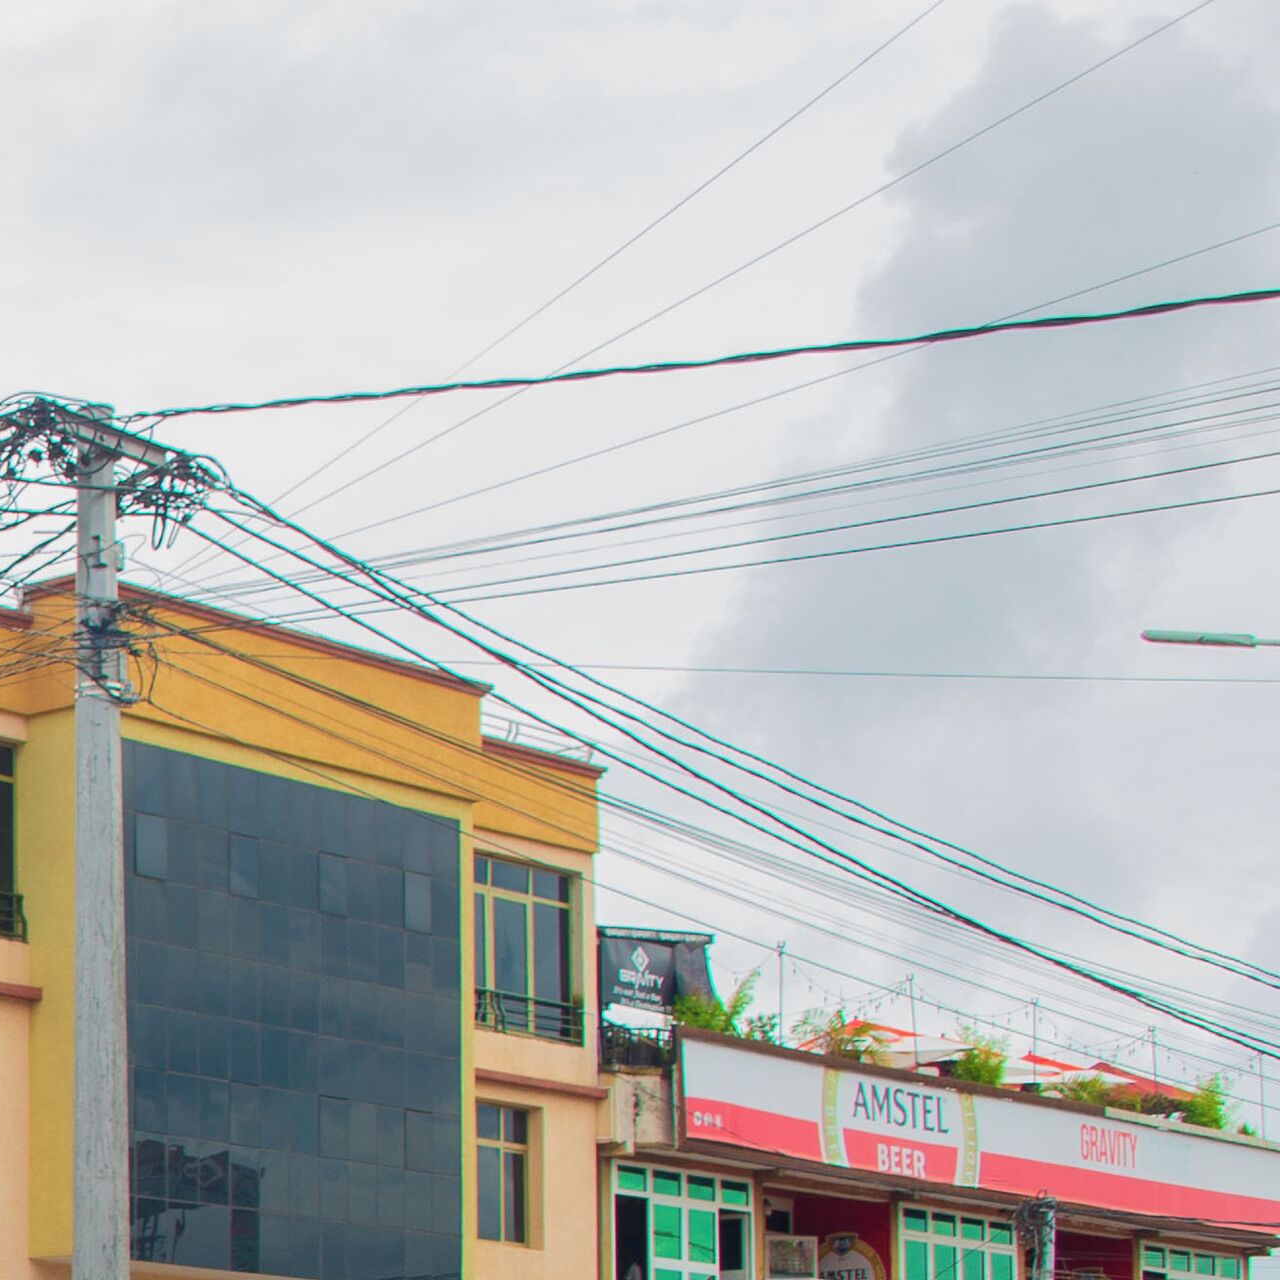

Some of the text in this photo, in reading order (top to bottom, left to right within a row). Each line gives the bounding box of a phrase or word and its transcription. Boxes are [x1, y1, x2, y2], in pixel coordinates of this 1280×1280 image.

[852, 1082, 950, 1134] AMSTEL
[876, 1143, 927, 1180] BEER
[1080, 1123, 1138, 1169] GRAVITY
